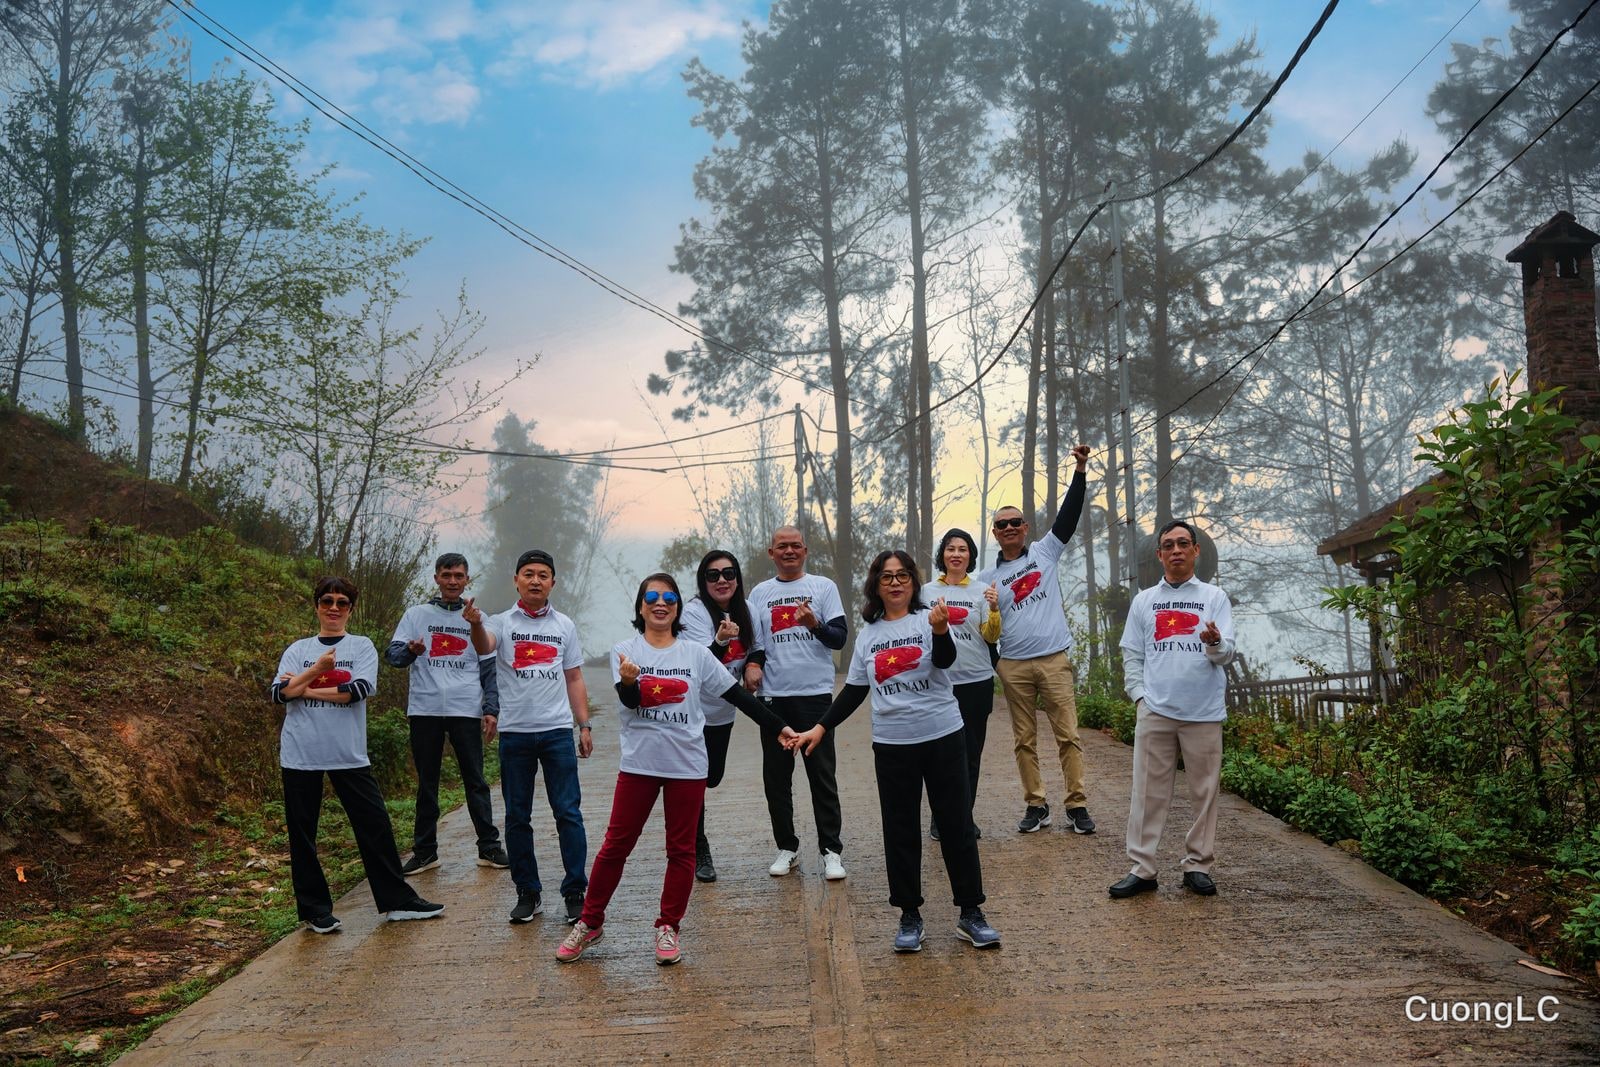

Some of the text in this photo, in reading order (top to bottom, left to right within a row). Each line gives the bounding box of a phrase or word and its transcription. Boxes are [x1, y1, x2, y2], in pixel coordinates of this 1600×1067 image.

[767, 597, 783, 609] Good
[946, 600, 974, 608] morning
[1030, 590, 1048, 606] NAM
[1152, 601, 1205, 611] Good morning
[427, 625, 471, 636] Good morning
[511, 632, 562, 645] Good morning
[771, 631, 814, 644] VIET NAM
[870, 634, 924, 653] Good morning
[1153, 641, 1202, 653] VIET NAM
[335, 659, 354, 670] rning
[427, 659, 466, 669] VIET NAM
[538, 669, 558, 681] NAM
[638, 665, 692, 678] ood morning
[876, 679, 930, 697] VIET NAM
[636, 707, 689, 724] VIET NAM
